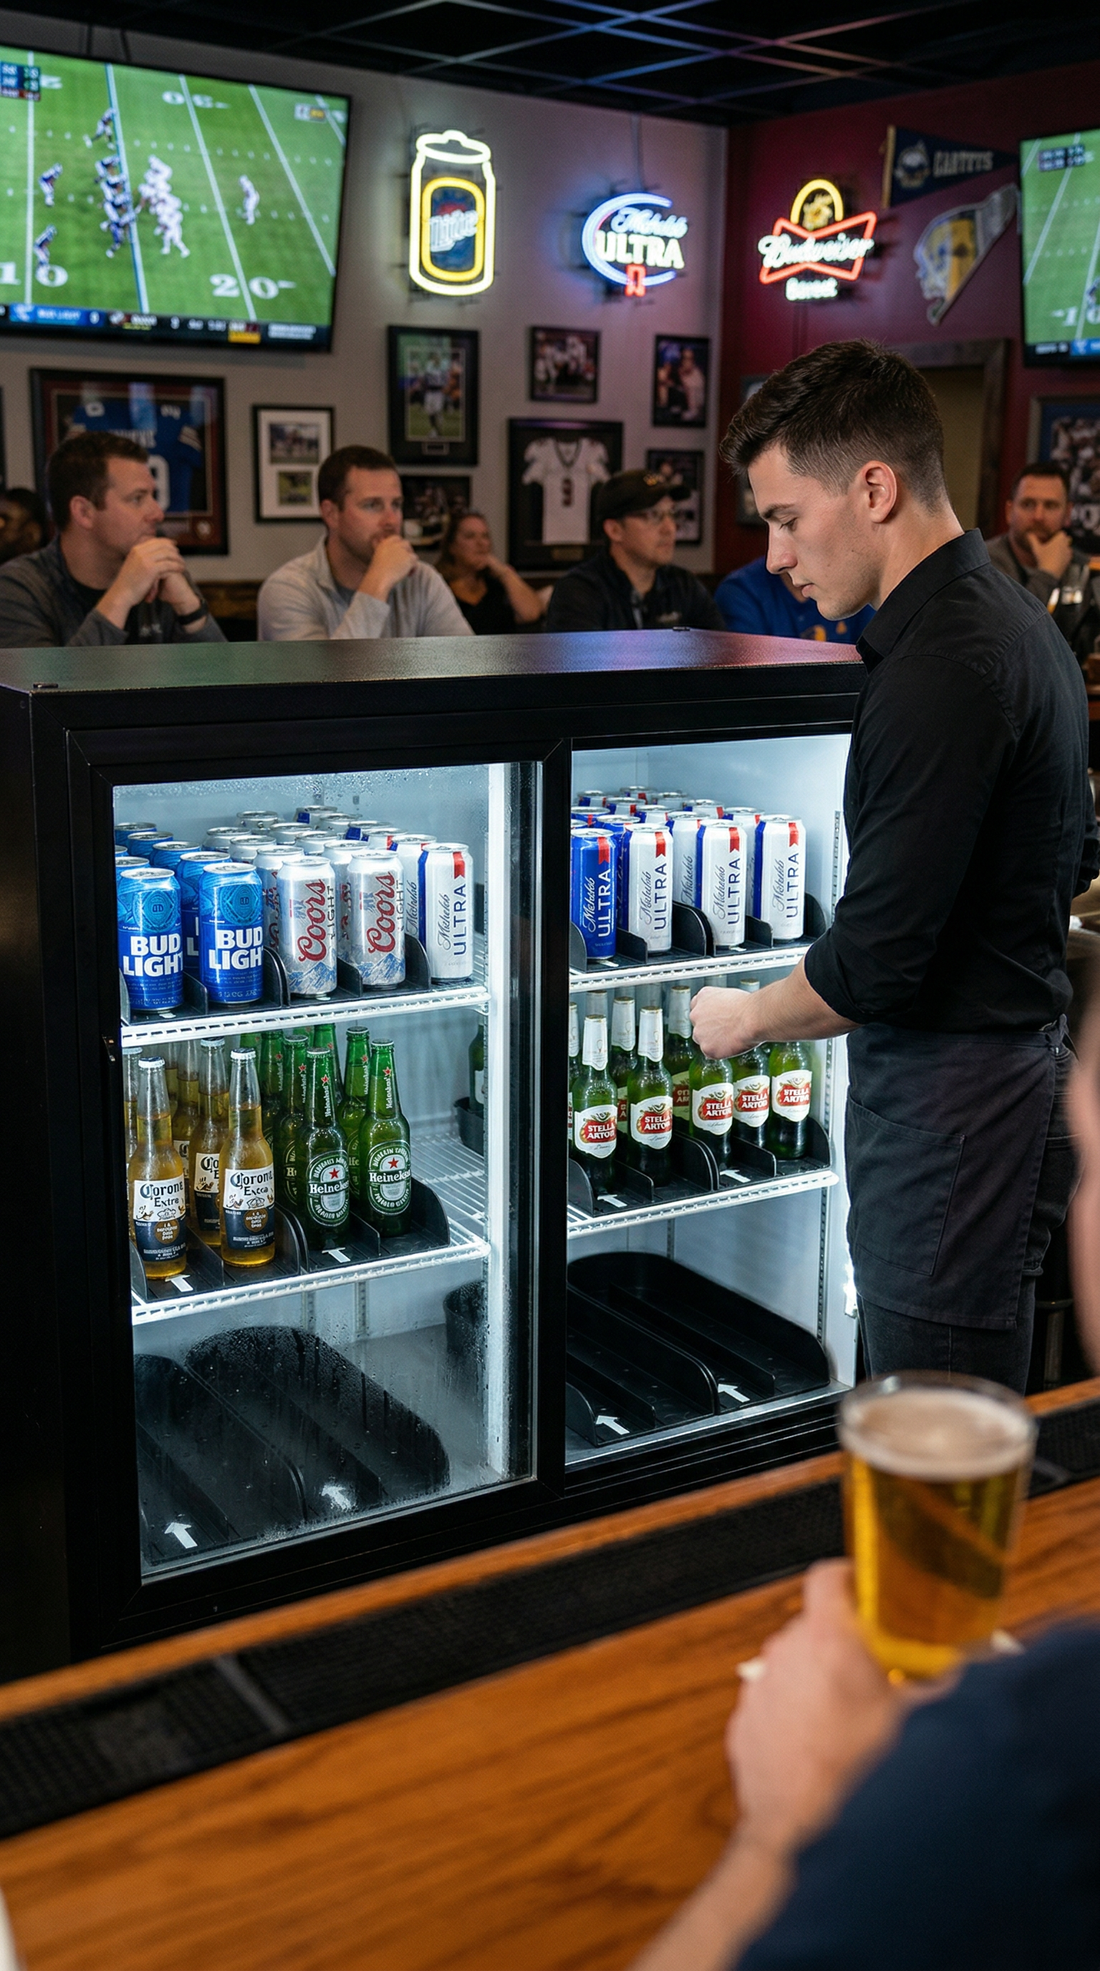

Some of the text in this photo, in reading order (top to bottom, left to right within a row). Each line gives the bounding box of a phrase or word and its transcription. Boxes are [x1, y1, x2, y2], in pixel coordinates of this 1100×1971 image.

[595, 229, 685, 269] ULTRA
[366, 871, 396, 954] Coors
[598, 868, 612, 938] ULTRA
[654, 863, 668, 931] ULTRA
[727, 858, 741, 925] ULTRA
[786, 853, 800, 919] ULTRA
[130, 933, 181, 956] BUD
[215, 926, 264, 949] BUD
[297, 879, 327, 962] Coors
[453, 883, 467, 956] ULTRA
[122, 950, 183, 977] LIGHT
[208, 946, 263, 970] LIGH
[587, 1122, 616, 1132] STELLA
